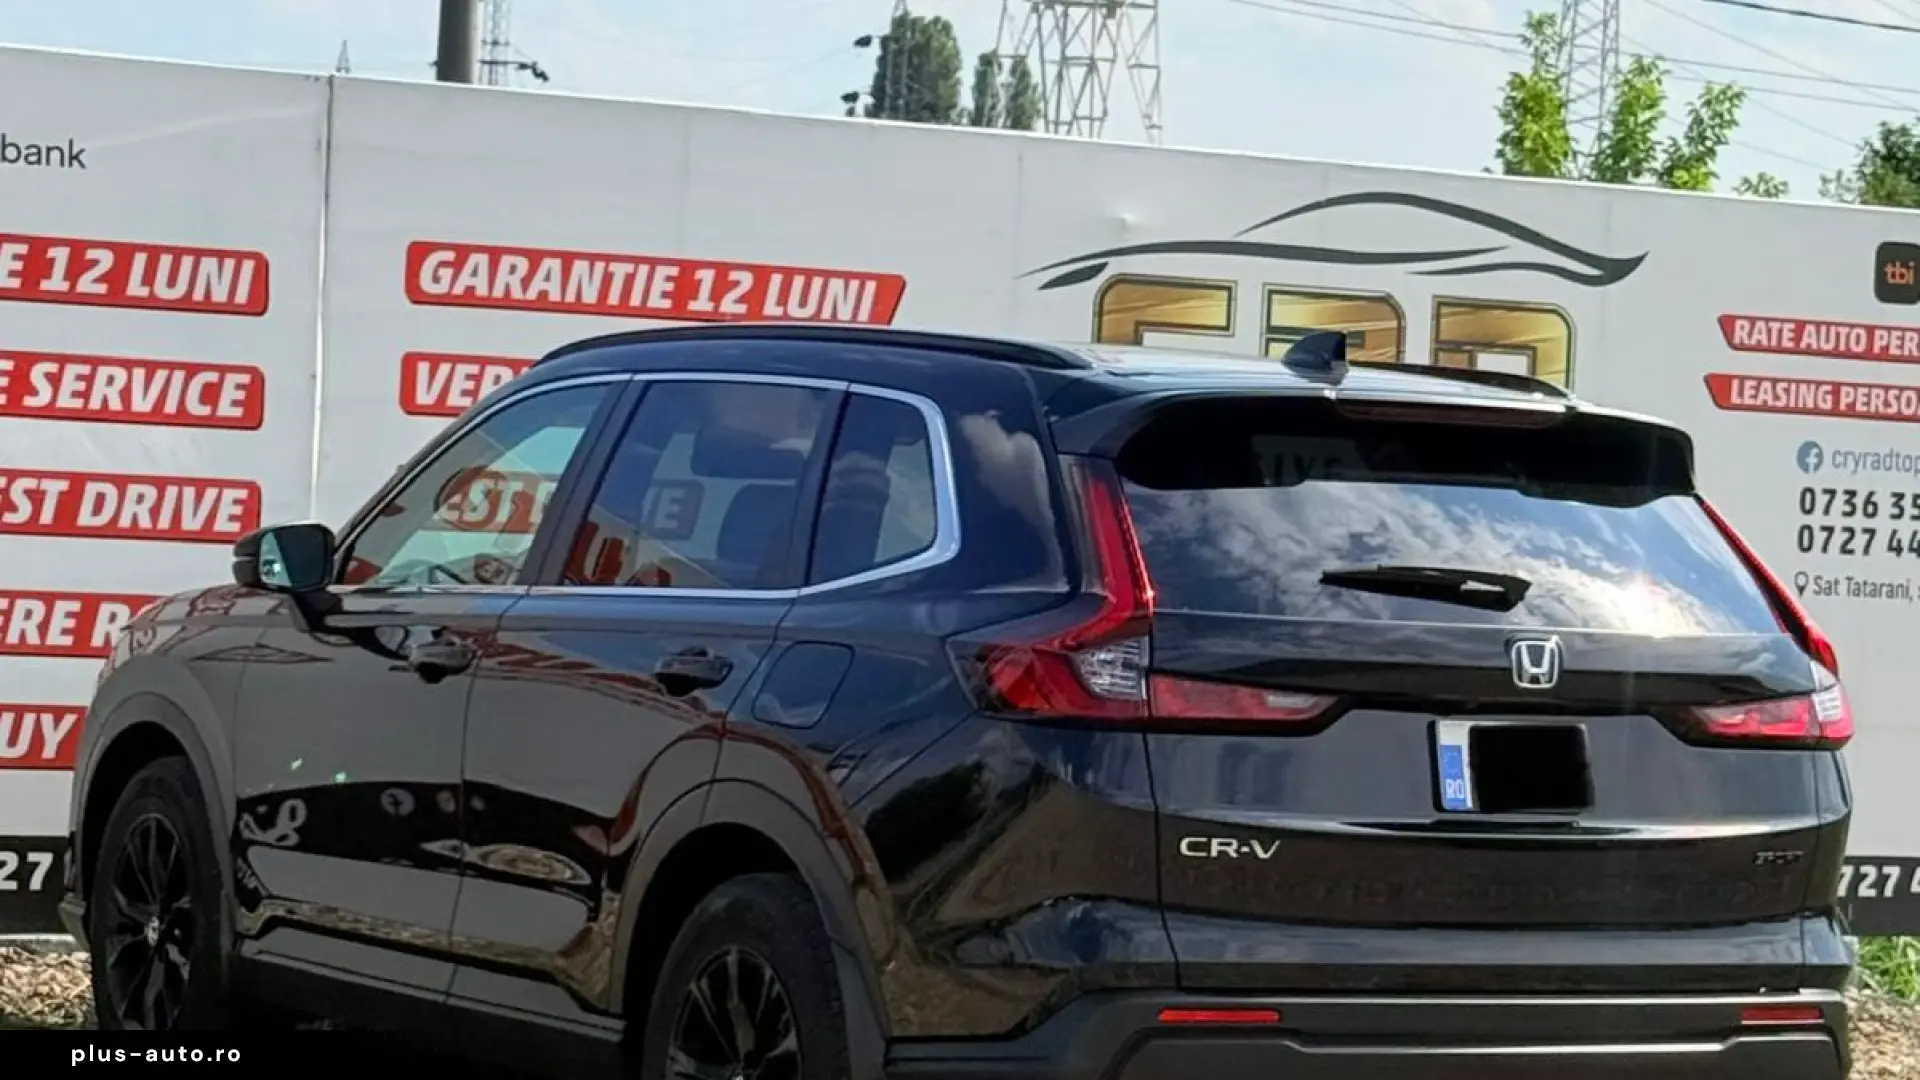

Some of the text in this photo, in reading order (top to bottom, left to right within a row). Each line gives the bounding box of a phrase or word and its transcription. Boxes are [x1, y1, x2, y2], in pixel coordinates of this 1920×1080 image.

[0, 132, 87, 169] bank
[39, 246, 115, 295] 12
[125, 252, 256, 305] LUNI
[418, 250, 877, 323] GARANTIE 12 LUNI
[1884, 261, 1915, 285] tbi
[1733, 319, 1796, 348] RATE
[1800, 324, 1867, 353] AUTO
[23, 362, 252, 418] SERVICE
[1730, 379, 1920, 417] LEASING PERSO
[0, 476, 248, 533] ST DRIVE
[1799, 487, 1879, 519] 0736
[1797, 524, 1877, 556] 0727
[1812, 574, 1840, 597] Sat
[1844, 576, 1914, 601] Tatarani,
[0, 598, 81, 646] RE
[1445, 779, 1464, 799] RO
[1179, 837, 1281, 860] CR-V
